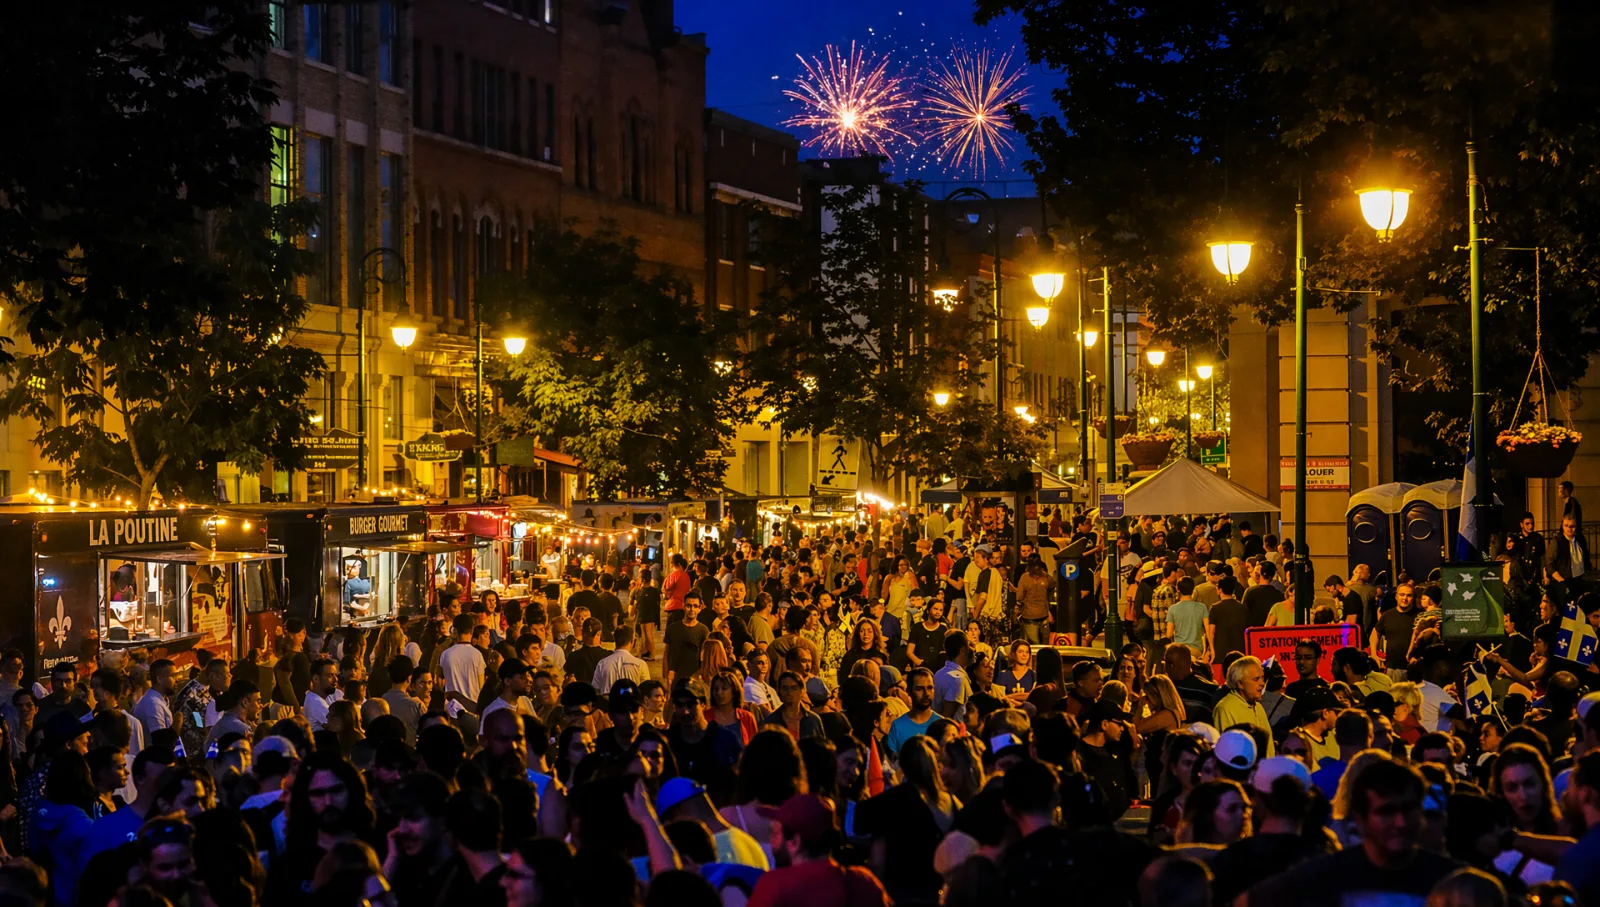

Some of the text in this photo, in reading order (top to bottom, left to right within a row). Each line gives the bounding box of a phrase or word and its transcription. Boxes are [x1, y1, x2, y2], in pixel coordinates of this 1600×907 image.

[89, 517, 178, 546] LA POUTINE
[349, 517, 376, 535] BURGER
[378, 514, 408, 532] GOURMET
[1065, 564, 1076, 577] P
